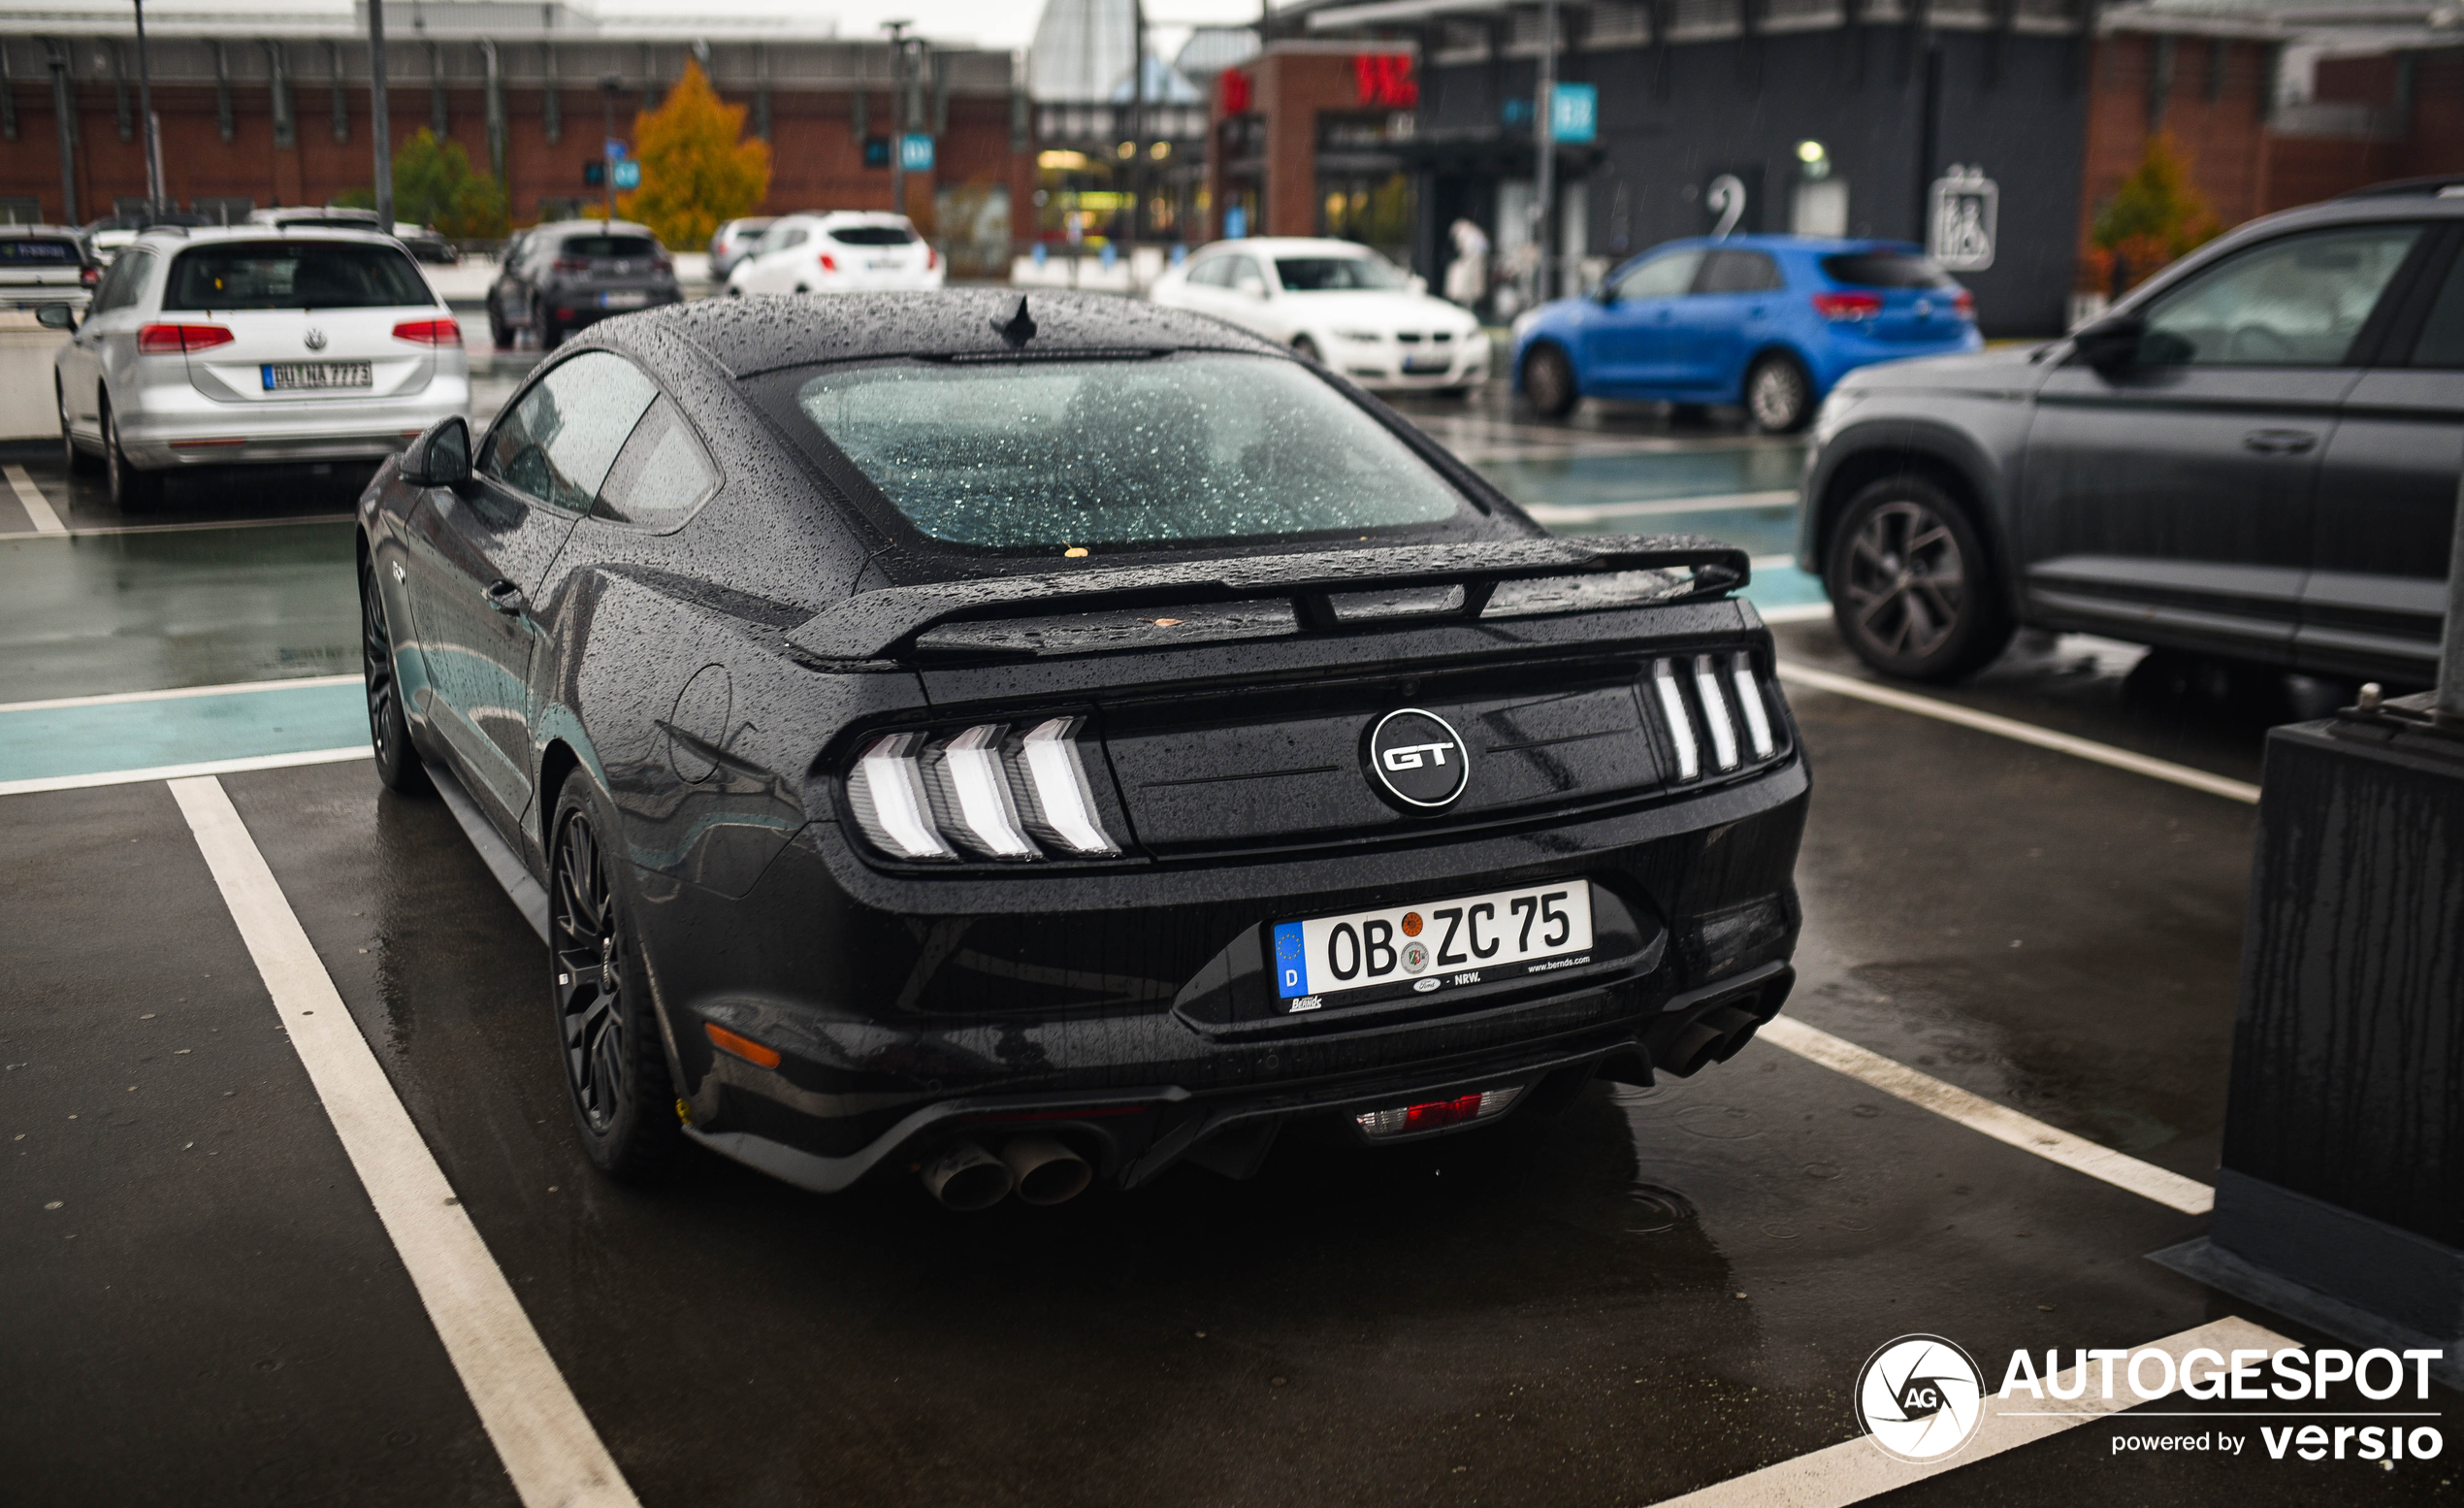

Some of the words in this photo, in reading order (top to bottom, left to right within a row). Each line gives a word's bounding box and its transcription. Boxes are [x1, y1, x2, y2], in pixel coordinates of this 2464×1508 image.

[1382, 741, 1454, 771] GT
[1328, 919, 1398, 981] OB
[1433, 902, 1500, 967] ZC
[1510, 891, 1571, 952] 75
[1527, 955, 1591, 973] www.bernds.com
[1285, 968, 1298, 987] D
[1455, 971, 1481, 986] NRW.
